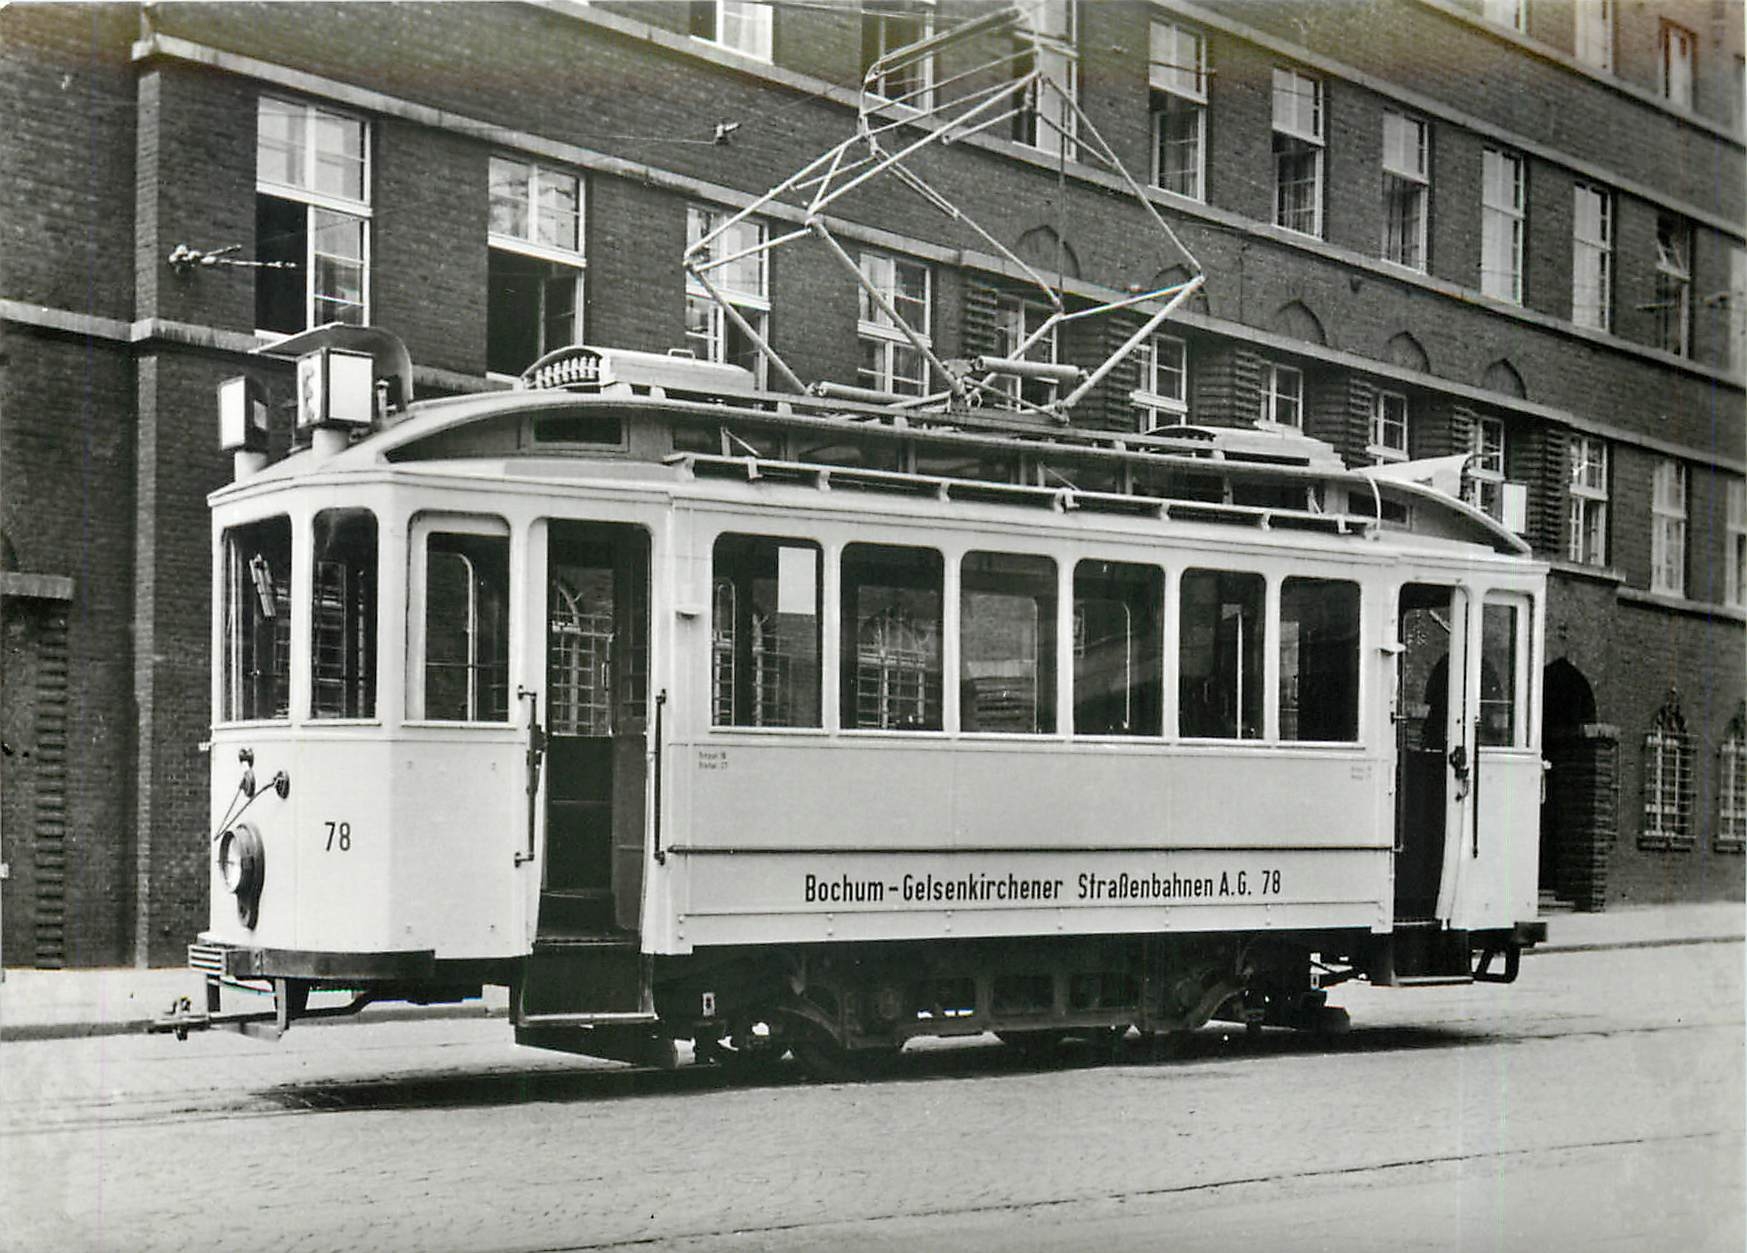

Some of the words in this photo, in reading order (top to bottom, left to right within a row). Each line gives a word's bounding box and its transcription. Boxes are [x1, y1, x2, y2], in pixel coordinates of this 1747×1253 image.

[325, 822, 350, 851] 78
[1078, 872, 1213, 899] Straßenbahnen
[1219, 871, 1252, 896] A.G.
[1262, 870, 1281, 895] 78
